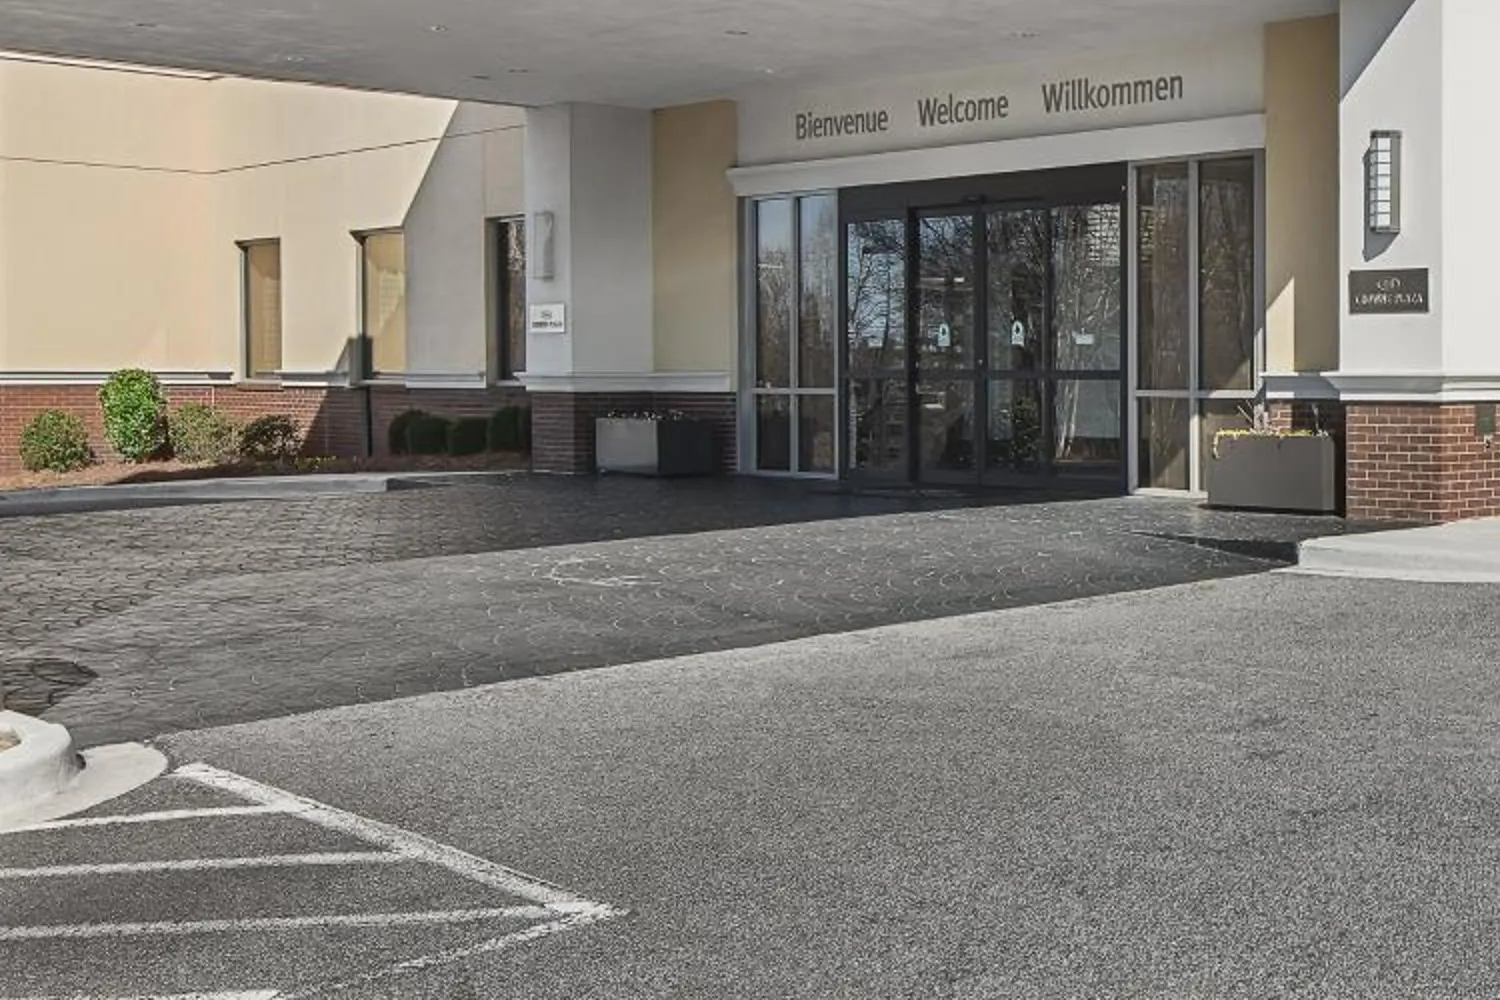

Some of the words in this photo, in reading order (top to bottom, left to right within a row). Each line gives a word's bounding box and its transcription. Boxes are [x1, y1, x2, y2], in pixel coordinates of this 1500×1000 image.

[795, 111, 889, 141] Bienvenue
[917, 93, 1009, 127] Welcome
[1041, 74, 1183, 114] Willkommen
